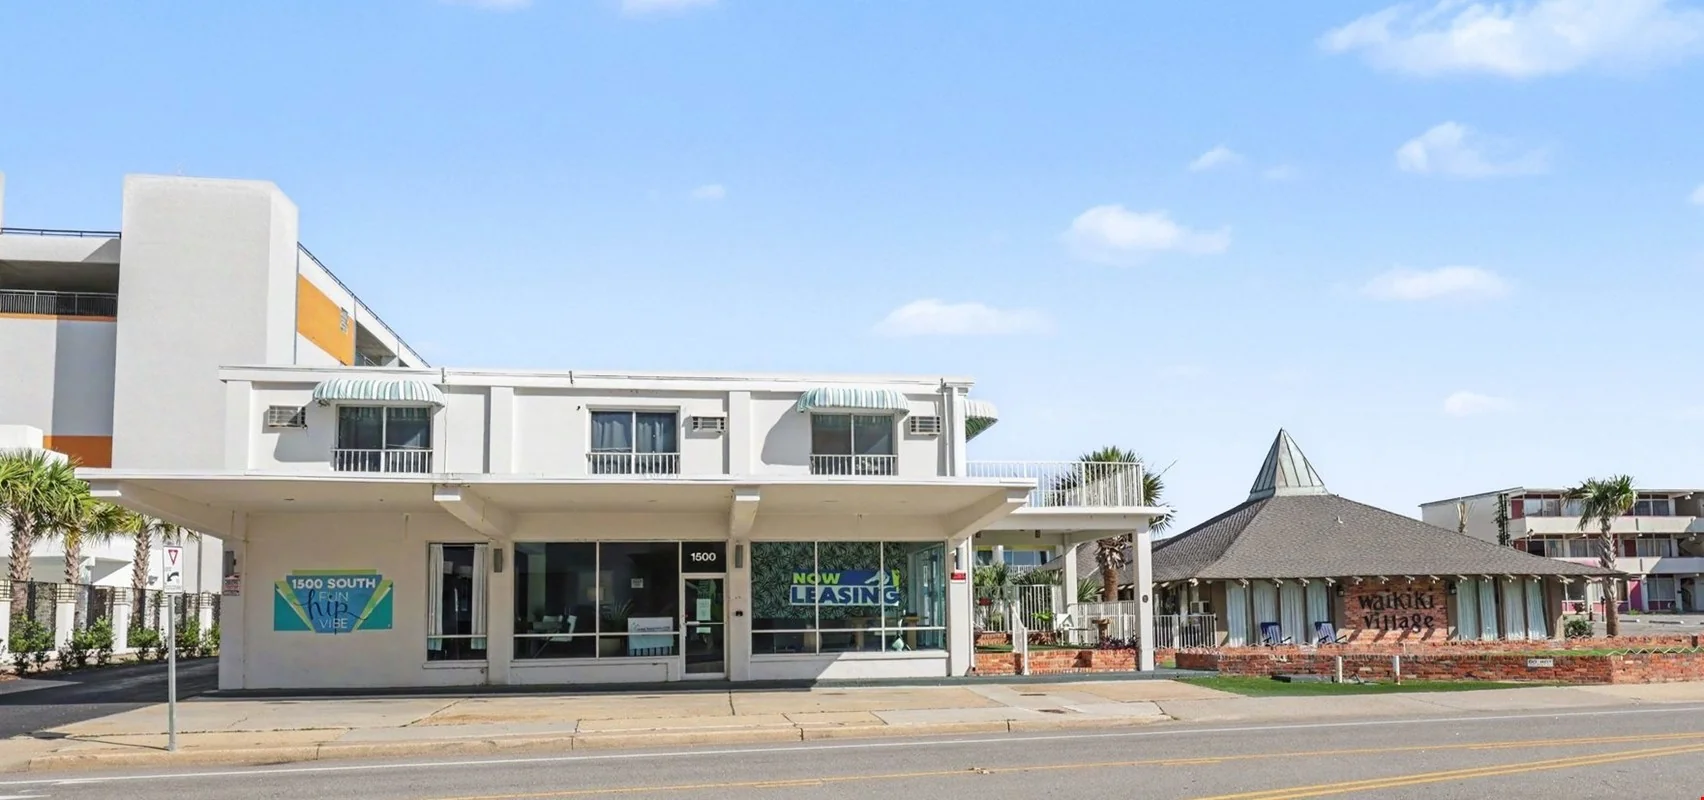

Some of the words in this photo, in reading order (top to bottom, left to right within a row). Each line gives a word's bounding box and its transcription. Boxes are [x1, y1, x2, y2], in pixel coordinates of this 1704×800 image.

[691, 552, 717, 562] 1500
[292, 579, 323, 589] 1500
[327, 578, 376, 588] SOUTH
[793, 572, 840, 584] NOW
[318, 591, 349, 602] FUN
[791, 586, 901, 604] LEASING
[1358, 586, 1435, 610] waikiki
[293, 589, 367, 635] hip
[319, 619, 348, 629] VIBE
